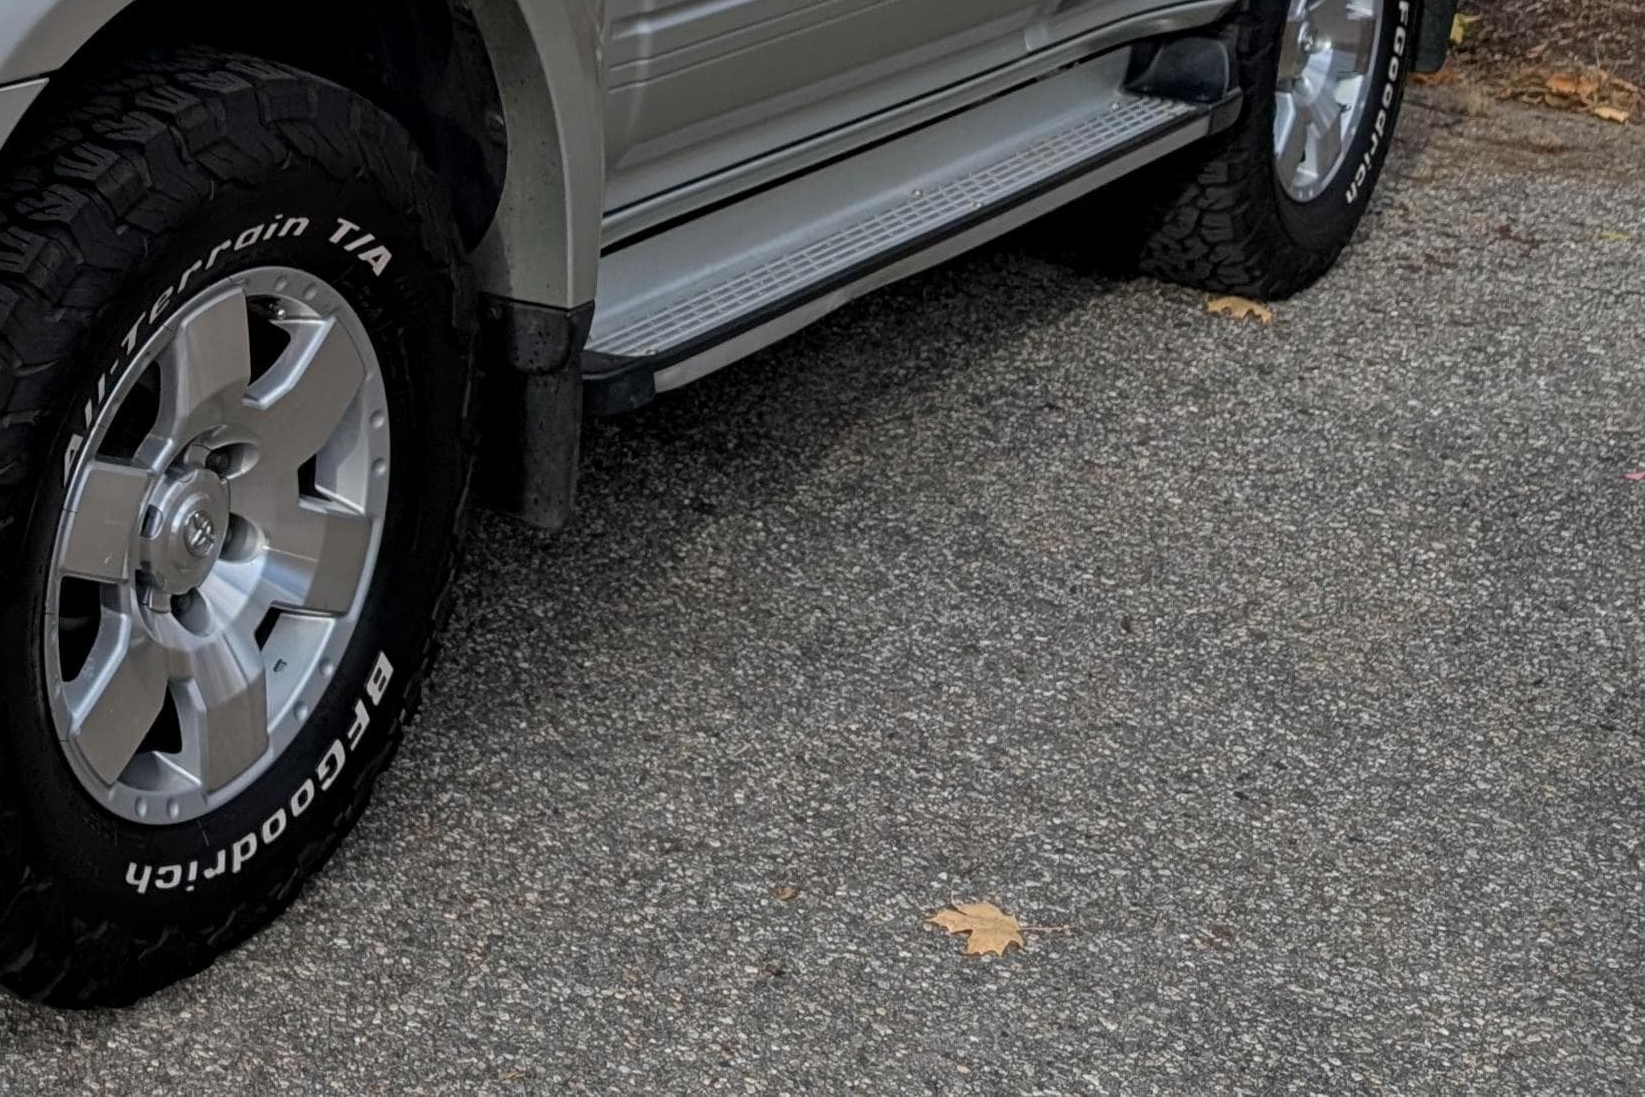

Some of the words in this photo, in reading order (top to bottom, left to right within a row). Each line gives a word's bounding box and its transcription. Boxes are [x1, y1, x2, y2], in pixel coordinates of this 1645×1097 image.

[63, 213, 310, 488] All-Terrain
[329, 217, 393, 278] T/A
[125, 650, 395, 895] BFGoodrich
